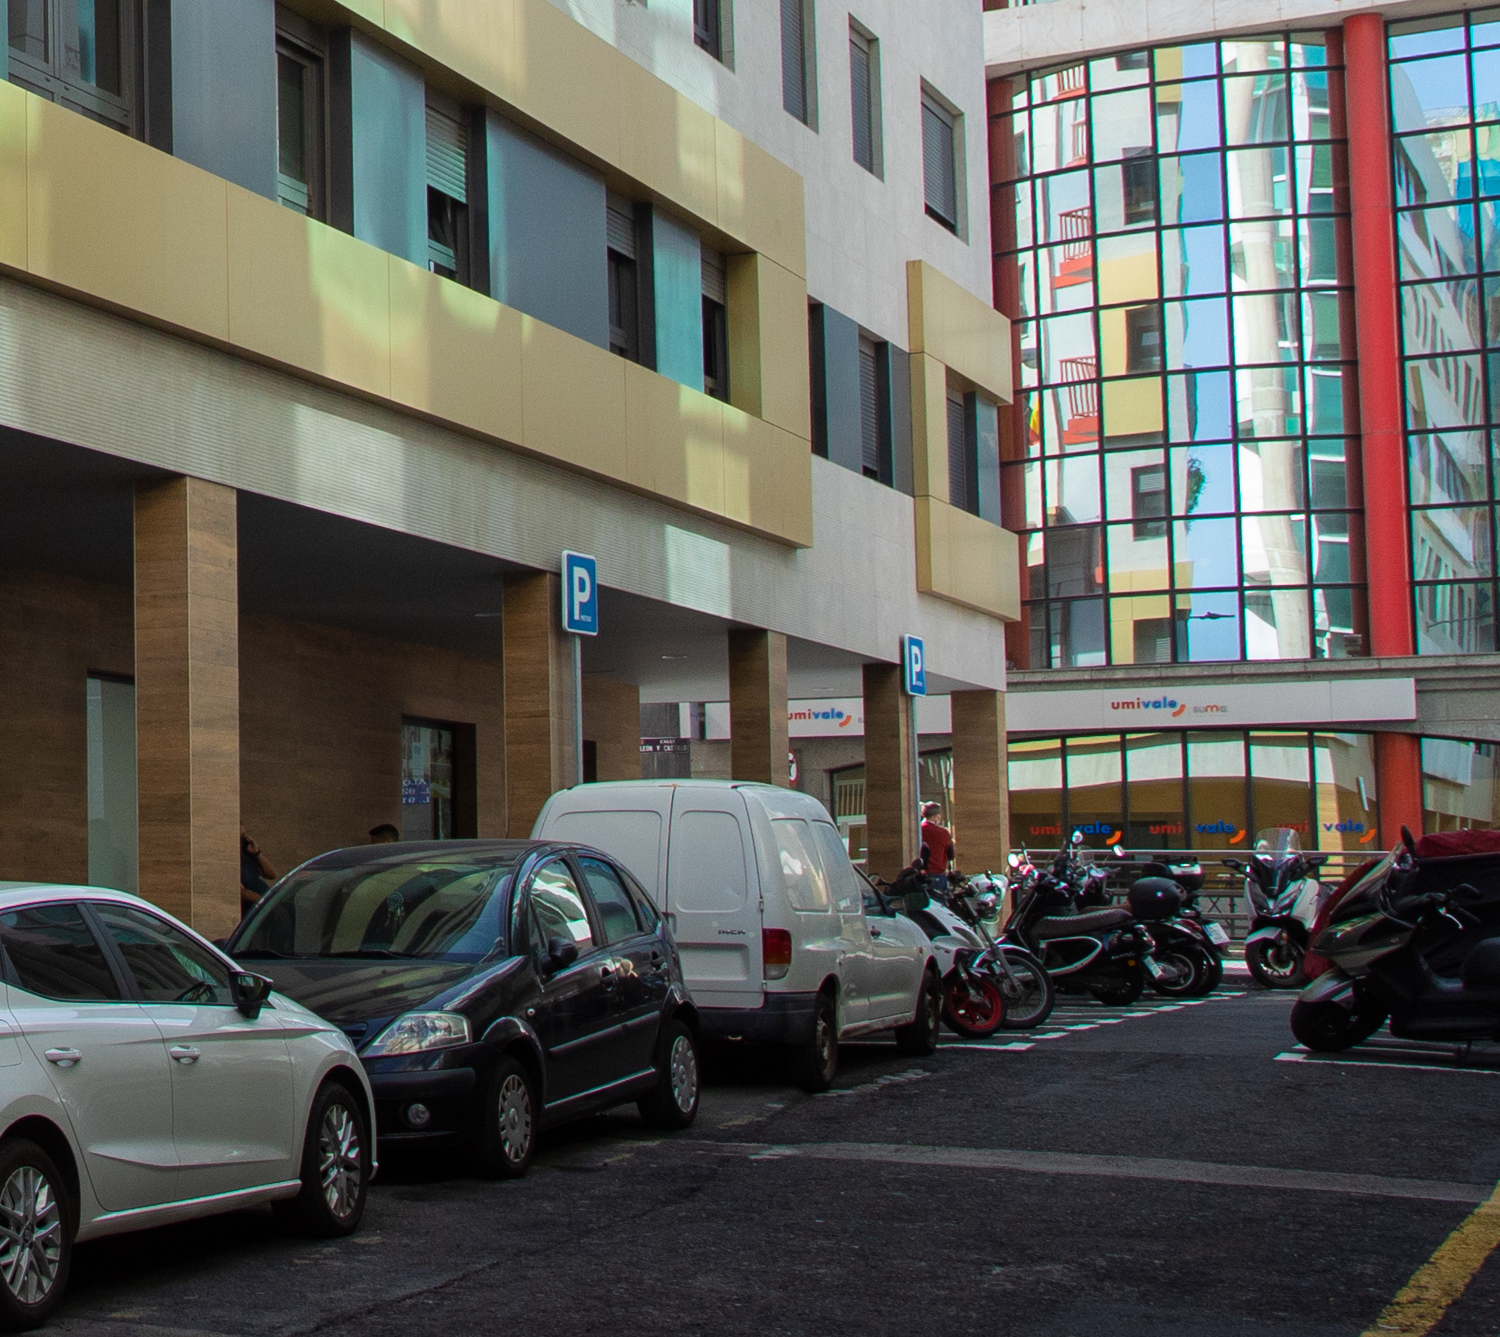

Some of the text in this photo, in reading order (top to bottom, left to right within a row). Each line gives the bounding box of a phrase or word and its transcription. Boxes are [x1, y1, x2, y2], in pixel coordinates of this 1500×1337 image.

[573, 566, 592, 620] P
[911, 645, 921, 685] P
[1111, 696, 1177, 710] umivale
[1195, 819, 1235, 833] vale
[1323, 819, 1365, 833] vale
